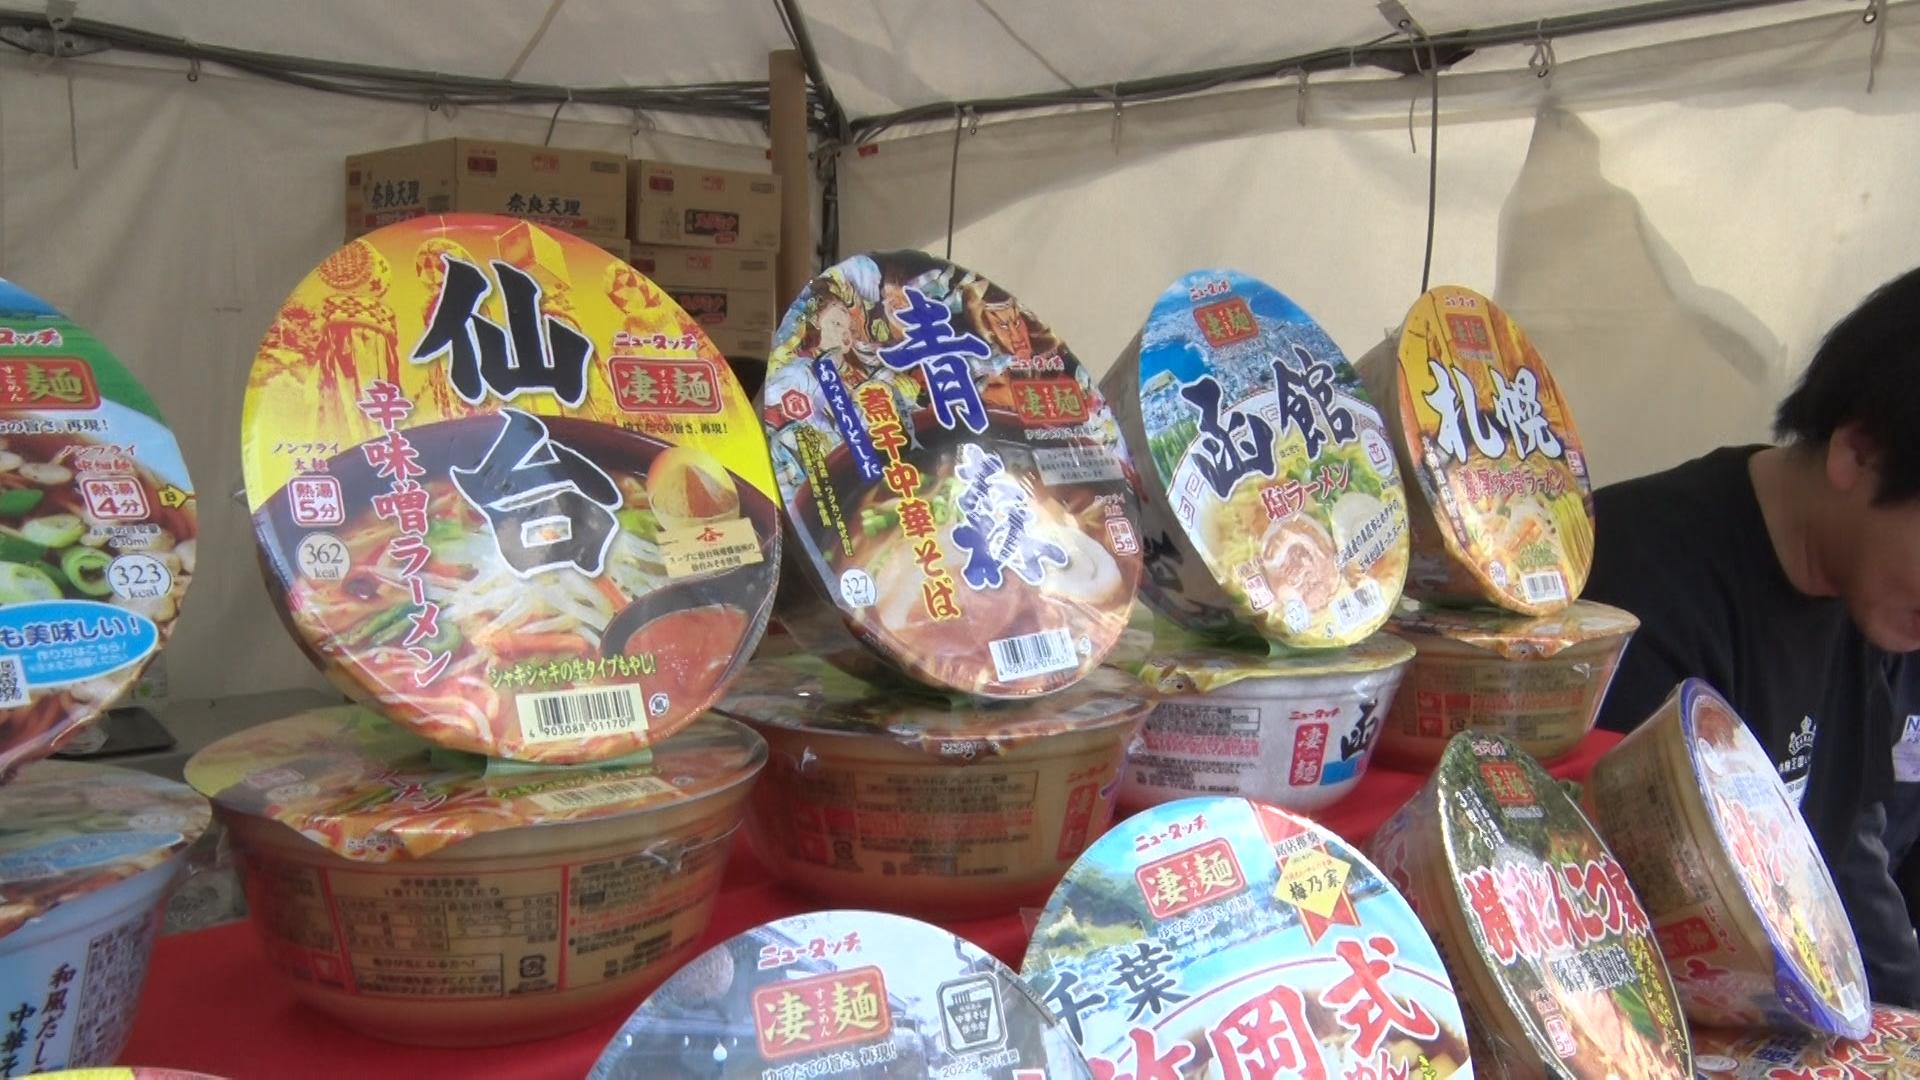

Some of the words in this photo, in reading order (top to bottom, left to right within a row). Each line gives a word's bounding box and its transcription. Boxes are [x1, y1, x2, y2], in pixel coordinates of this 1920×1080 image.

[371, 180, 421, 211] 奈良天理
[507, 192, 582, 217] 奈良天理
[614, 331, 698, 352] ニュータッチ
[619, 366, 713, 407] 凄麺
[410, 254, 625, 579] 仙台
[1180, 344, 1358, 500] 函館
[1422, 357, 1565, 464] 札幌
[97, 497, 140, 515] 4分
[300, 500, 337, 520] 5分
[359, 378, 452, 688] 辛味噌ラーメン
[304, 543, 343, 565] 362
[113, 562, 163, 587] 323
[1288, 706, 1341, 721] ニュータッチ
[1135, 814, 1207, 852] ニュータッチ
[1145, 850, 1239, 911] 凄麺
[757, 930, 863, 970] ニュータッチ
[764, 980, 880, 1047] 凄麺
[1042, 942, 1193, 1047] 千葉
